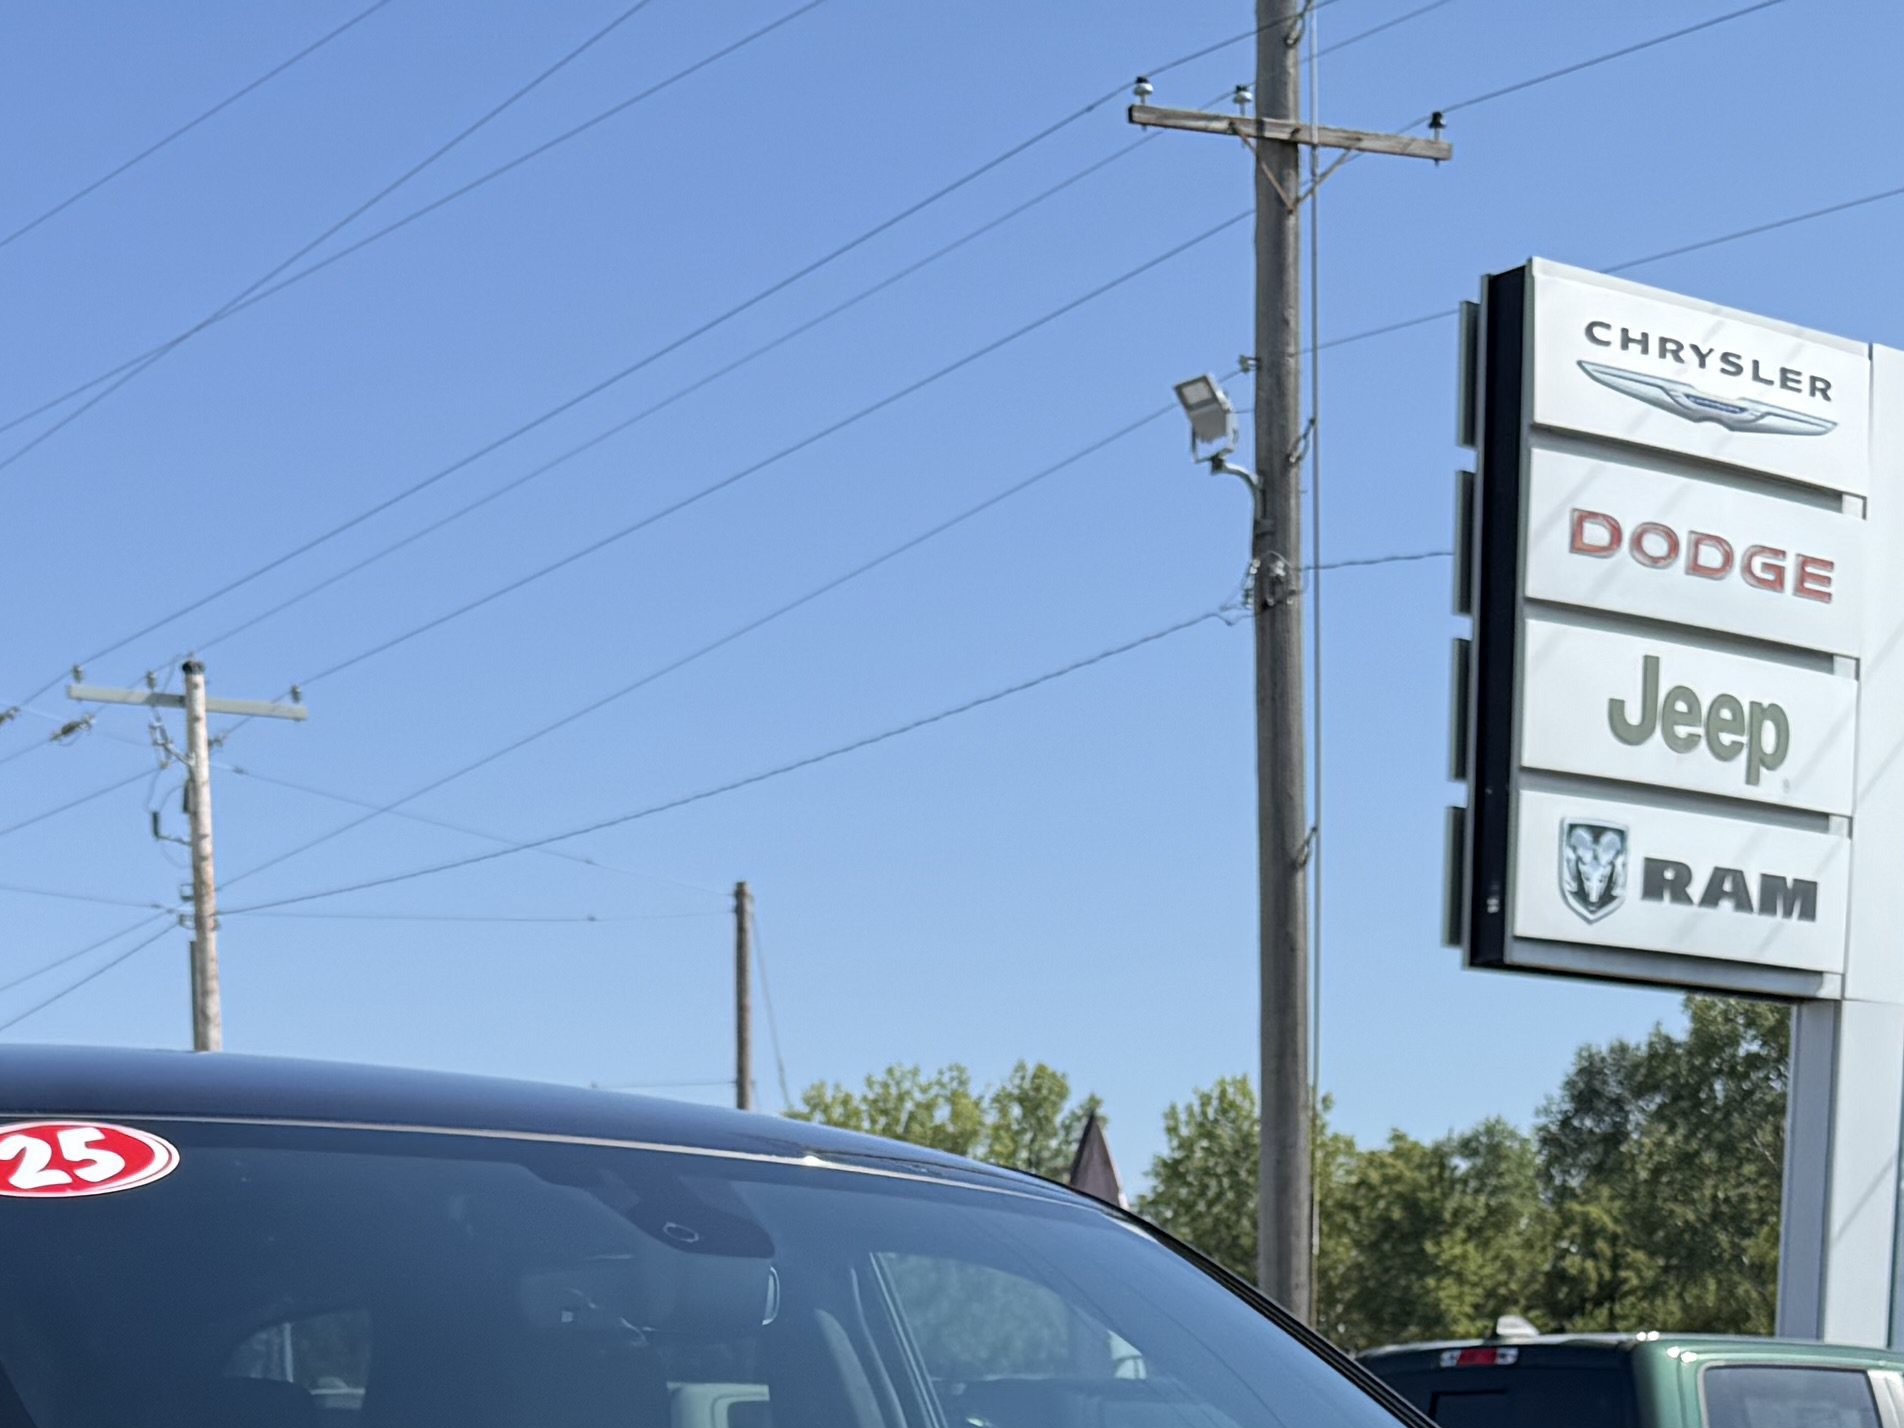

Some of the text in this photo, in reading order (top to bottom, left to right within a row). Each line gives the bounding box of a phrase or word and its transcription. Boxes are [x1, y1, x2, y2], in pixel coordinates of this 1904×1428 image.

[1584, 320, 1833, 402] CHRYSLER
[1569, 508, 1835, 604] DODGE
[1607, 654, 1790, 787] Jeep
[1641, 857, 1818, 922] RAM
